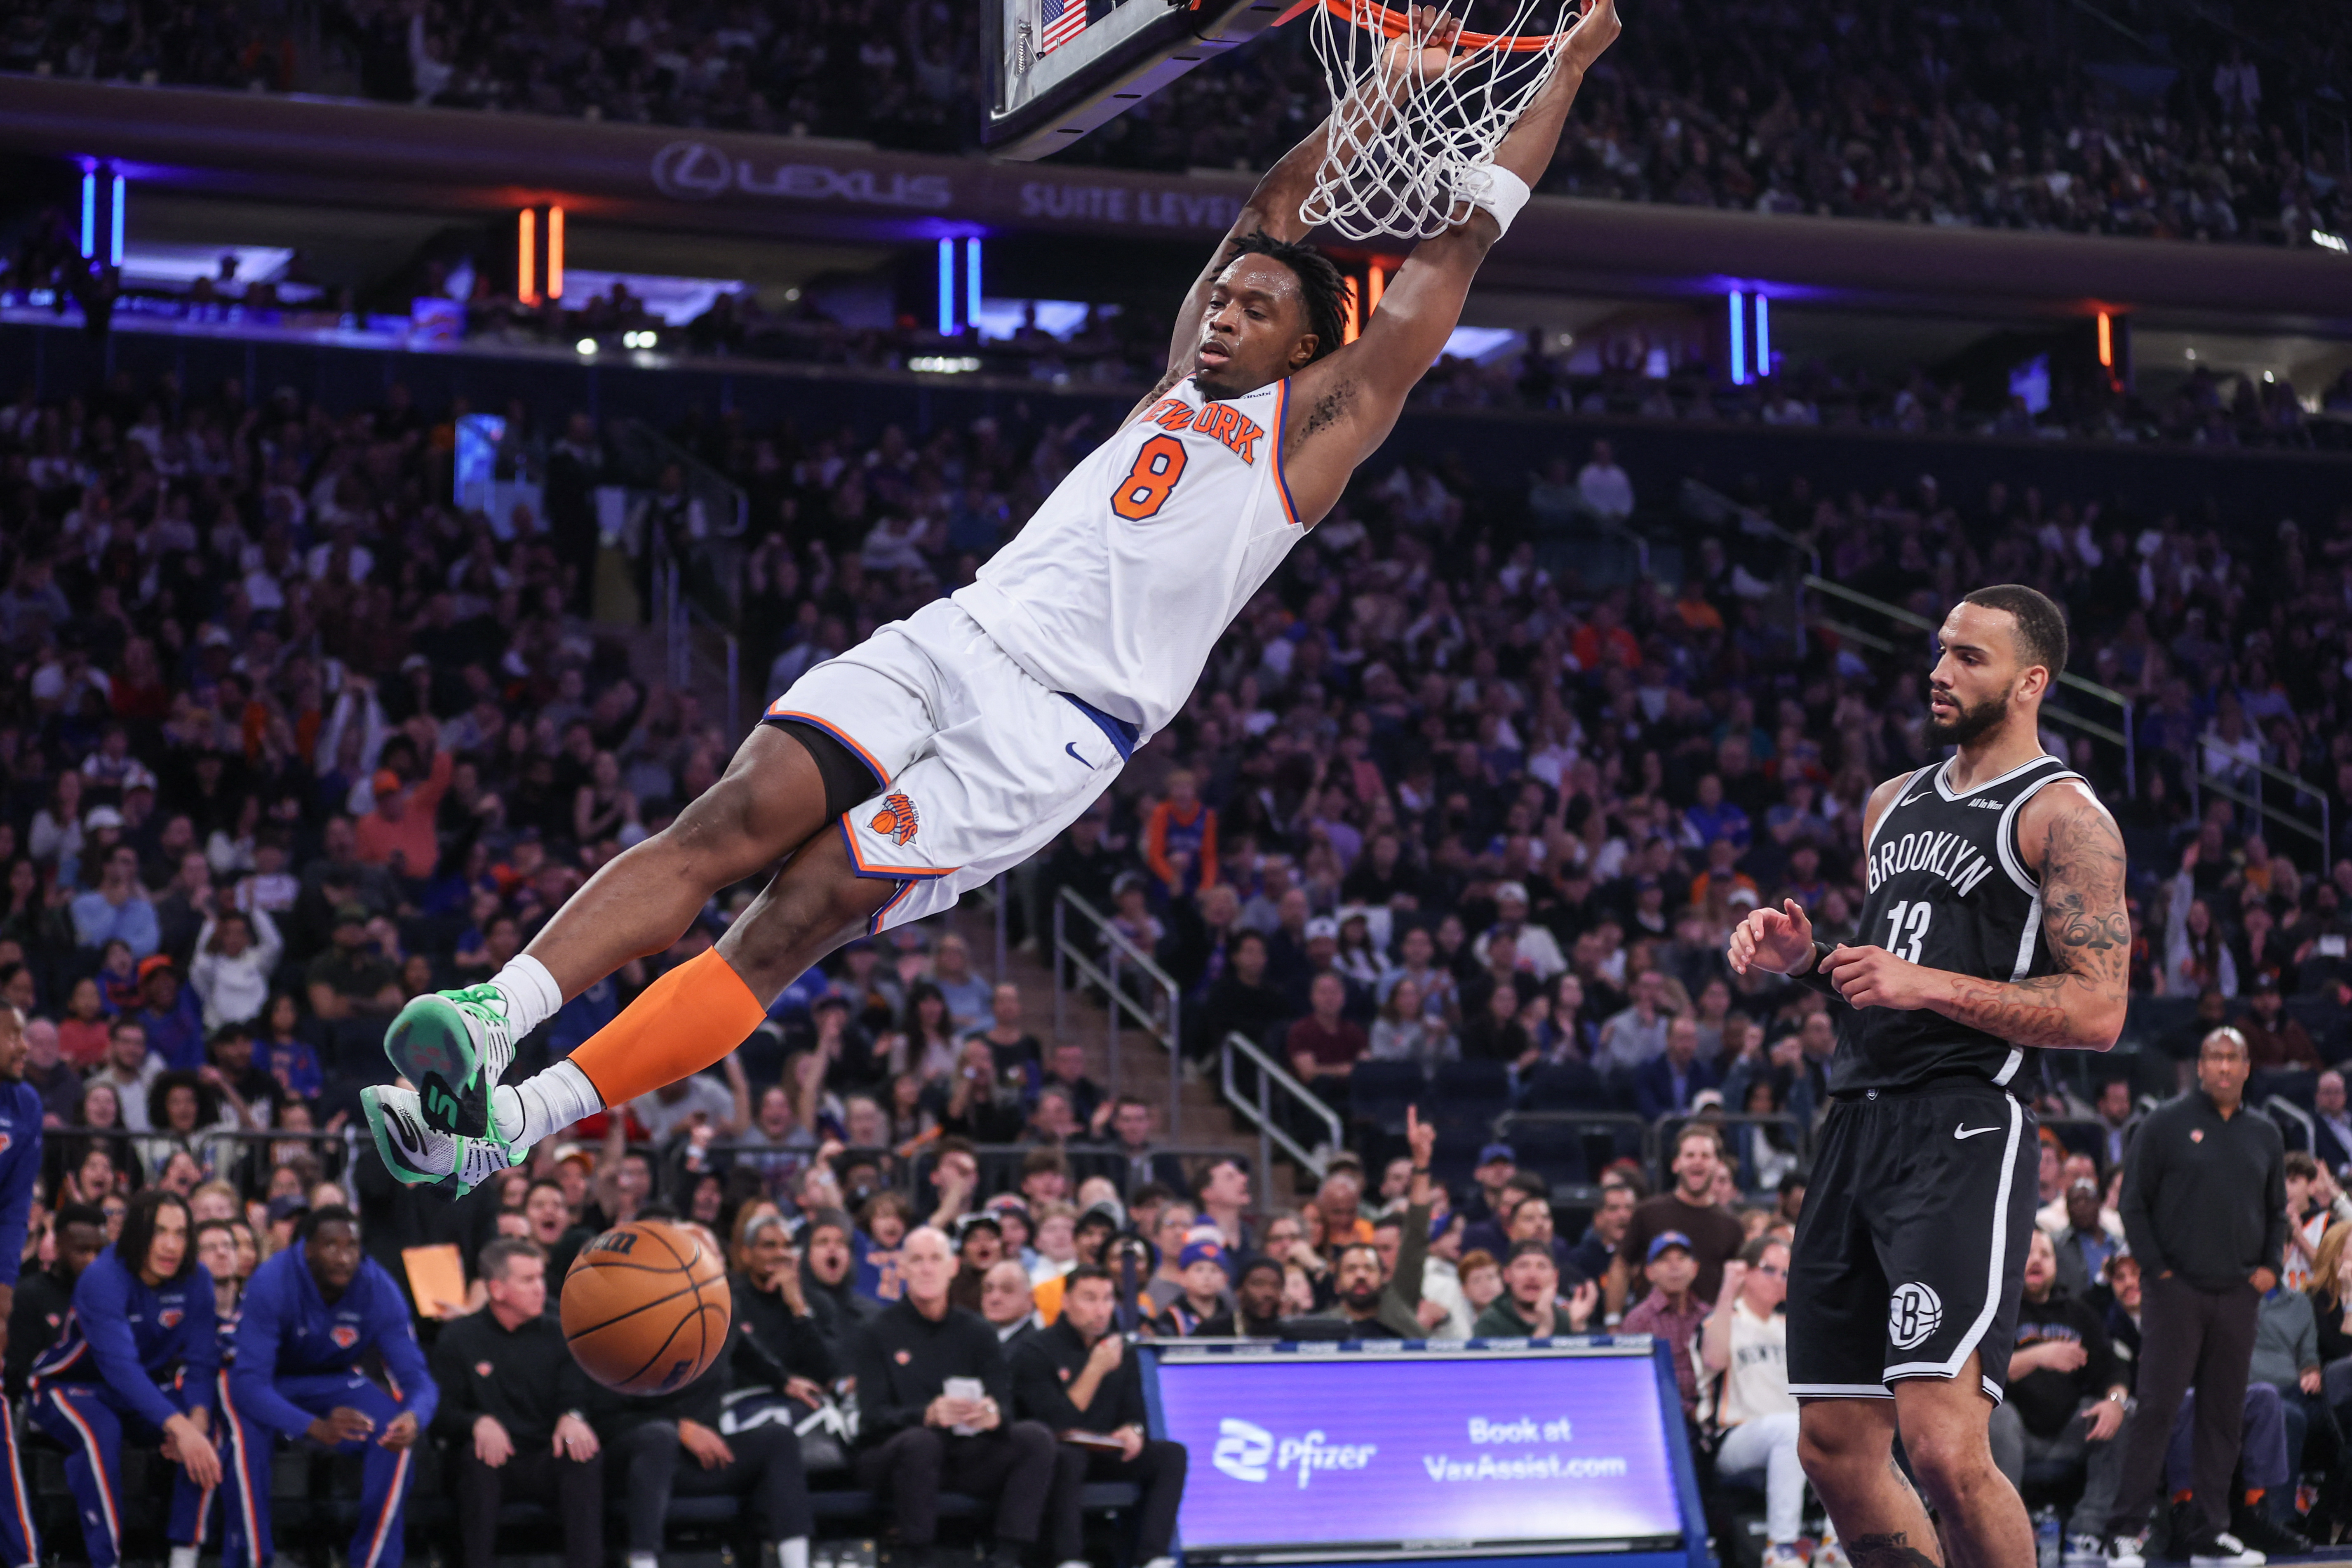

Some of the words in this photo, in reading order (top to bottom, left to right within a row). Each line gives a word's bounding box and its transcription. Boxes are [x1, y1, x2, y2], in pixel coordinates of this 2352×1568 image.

[739, 162, 952, 209] LEXUS
[1021, 182, 1128, 223] SUITE
[1192, 402, 1266, 469] ORK
[1110, 433, 1188, 522] 8
[886, 794, 918, 846] KNICKS
[908, 801, 917, 810] NEW
[1967, 798, 1983, 807] All
[1977, 798, 1988, 809] In
[1986, 799, 2004, 810] Won
[1868, 830, 1994, 898] BROOKLYN
[1886, 900, 1932, 965] 13
[1900, 1291, 1920, 1340] B
[1468, 1415, 1540, 1444] Book
[1543, 1415, 1573, 1443] at
[1277, 1428, 1378, 1490] Pfizer
[1422, 1453, 1628, 1482] VaxAssist.com
